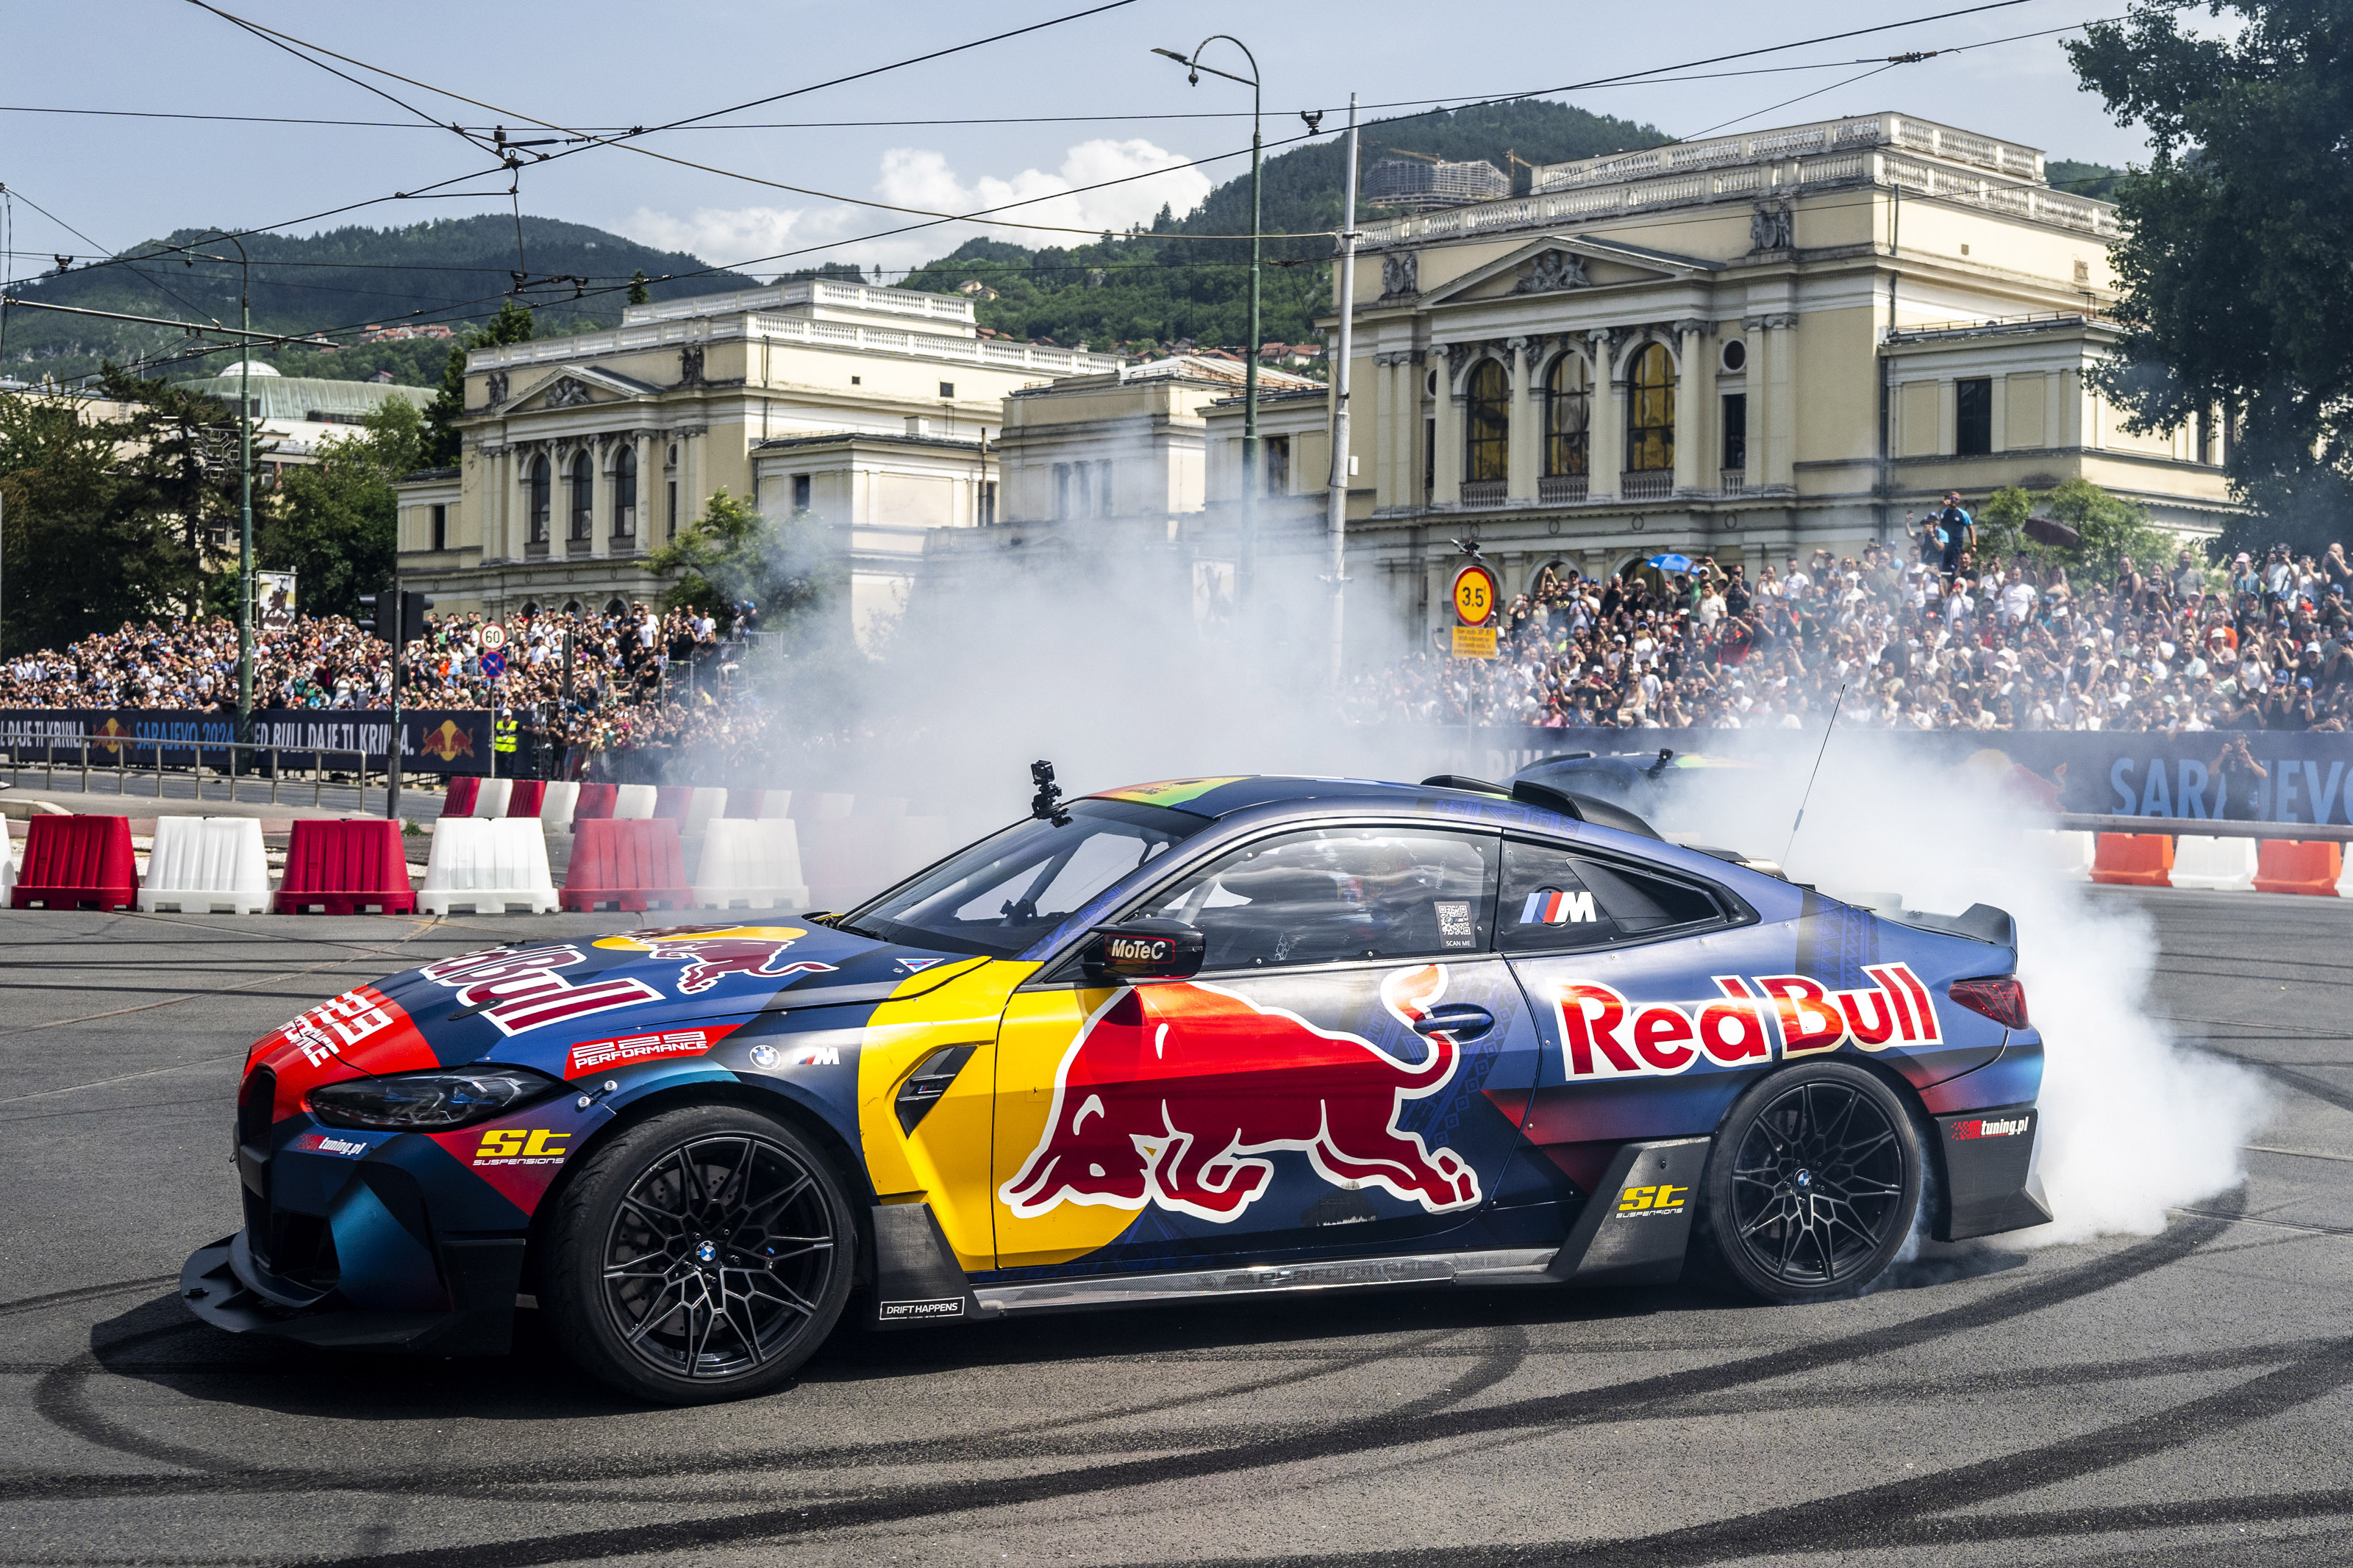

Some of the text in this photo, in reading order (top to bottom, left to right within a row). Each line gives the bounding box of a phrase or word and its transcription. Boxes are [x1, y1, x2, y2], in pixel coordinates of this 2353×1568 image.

[486, 631, 500, 643] 60
[7, 720, 32, 747] DAJE
[35, 721, 43, 747] TI
[136, 722, 235, 751] SARAJEVO 2024
[251, 723, 415, 756] ED BULL DAJE TI KRIIA.
[1111, 939, 1166, 960] MoTeC
[1549, 964, 1940, 1078] Red Bull
[574, 1041, 709, 1070] PERFORMANCE
[886, 1302, 958, 1314] DRIFT HAPPENS
